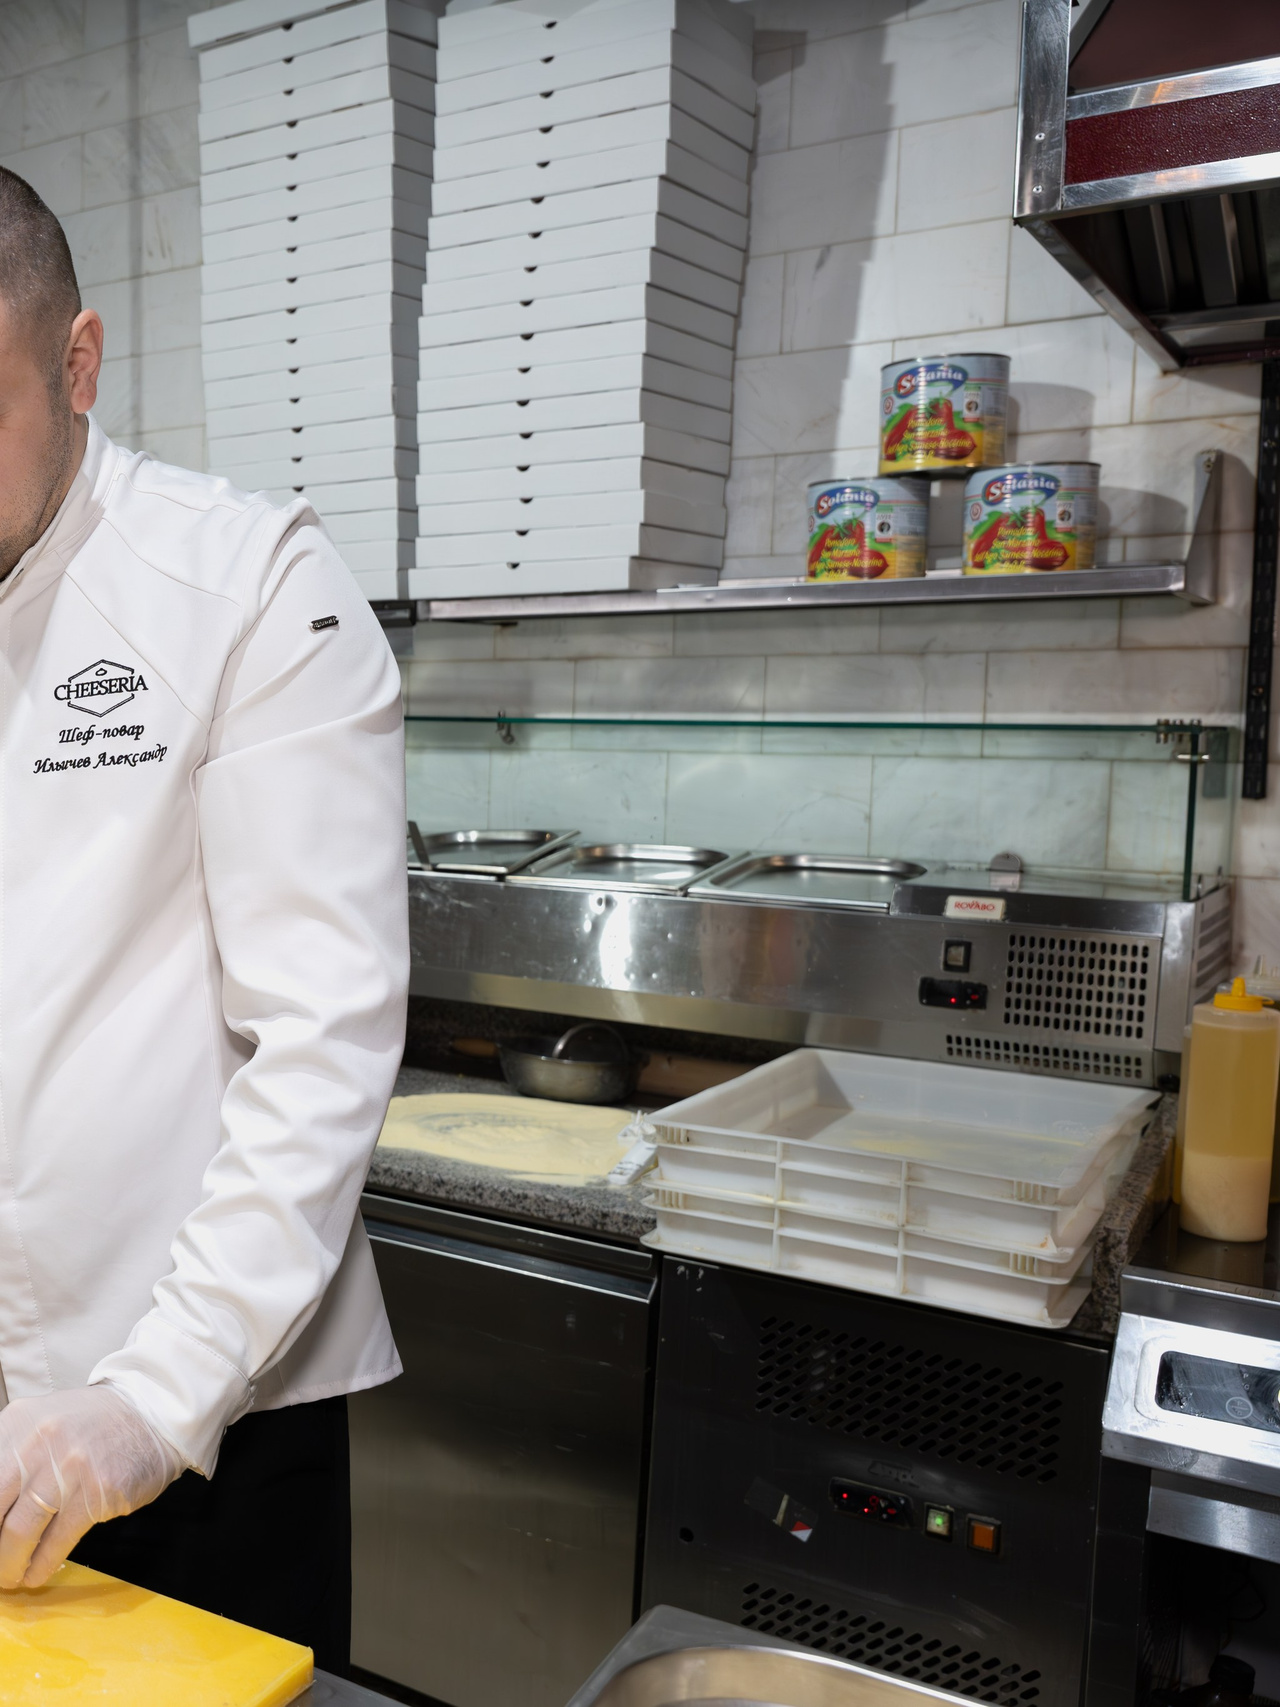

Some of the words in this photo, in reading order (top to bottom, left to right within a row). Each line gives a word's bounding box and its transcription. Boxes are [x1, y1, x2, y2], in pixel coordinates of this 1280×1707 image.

[988, 477, 1056, 501] Solania
[818, 490, 875, 514] Solania
[54, 675, 148, 701] CHEESERIA
[58, 725, 145, 746] Шеф-повар
[92, 743, 168, 769] Александр
